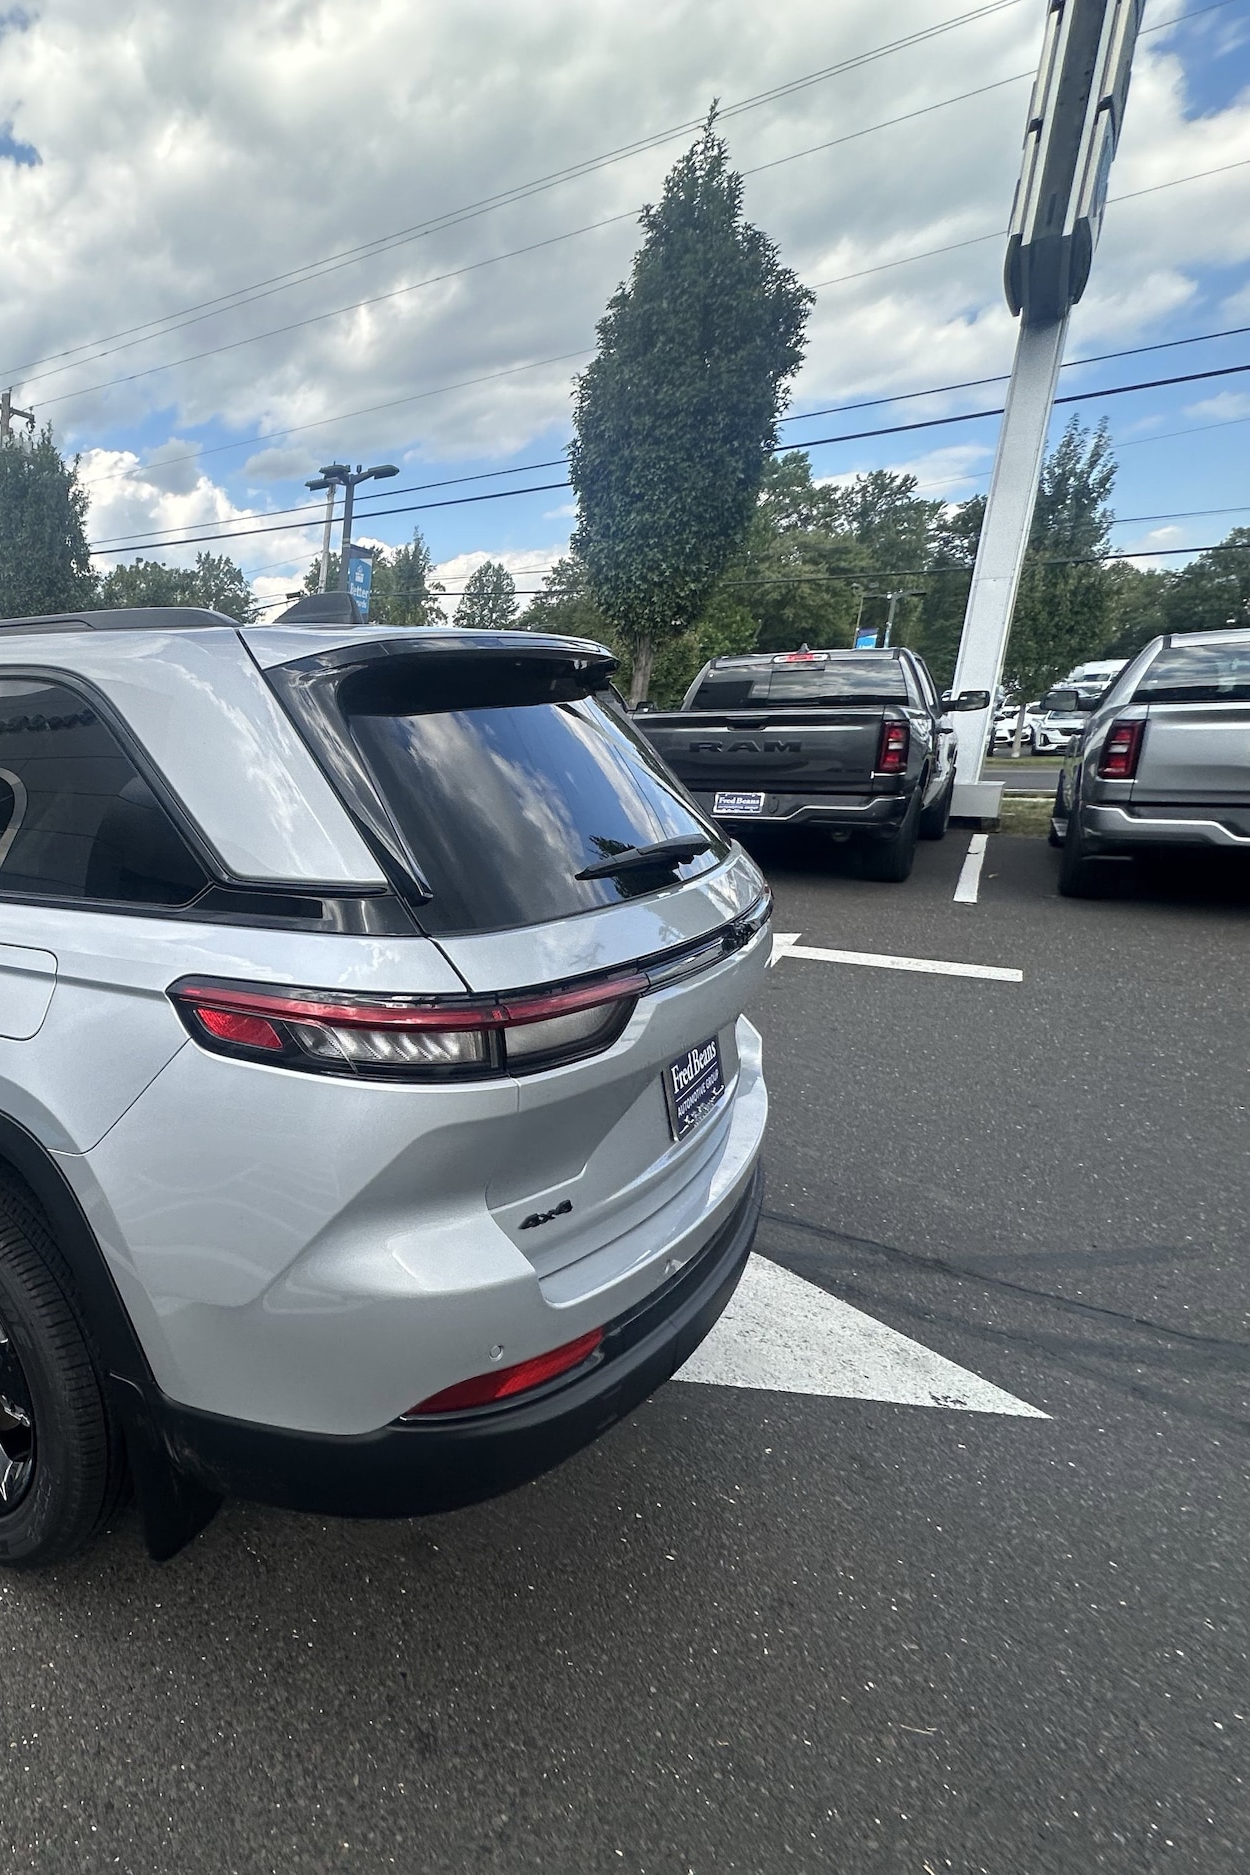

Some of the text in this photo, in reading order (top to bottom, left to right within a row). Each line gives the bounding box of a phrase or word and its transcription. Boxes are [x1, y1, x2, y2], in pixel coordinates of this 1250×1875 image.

[690, 740, 802, 752] RAM
[719, 796, 760, 805] Fred Beans
[671, 1041, 717, 1094] Fred Beans
[678, 1068, 719, 1118] AUTOMOTIVE GROUP
